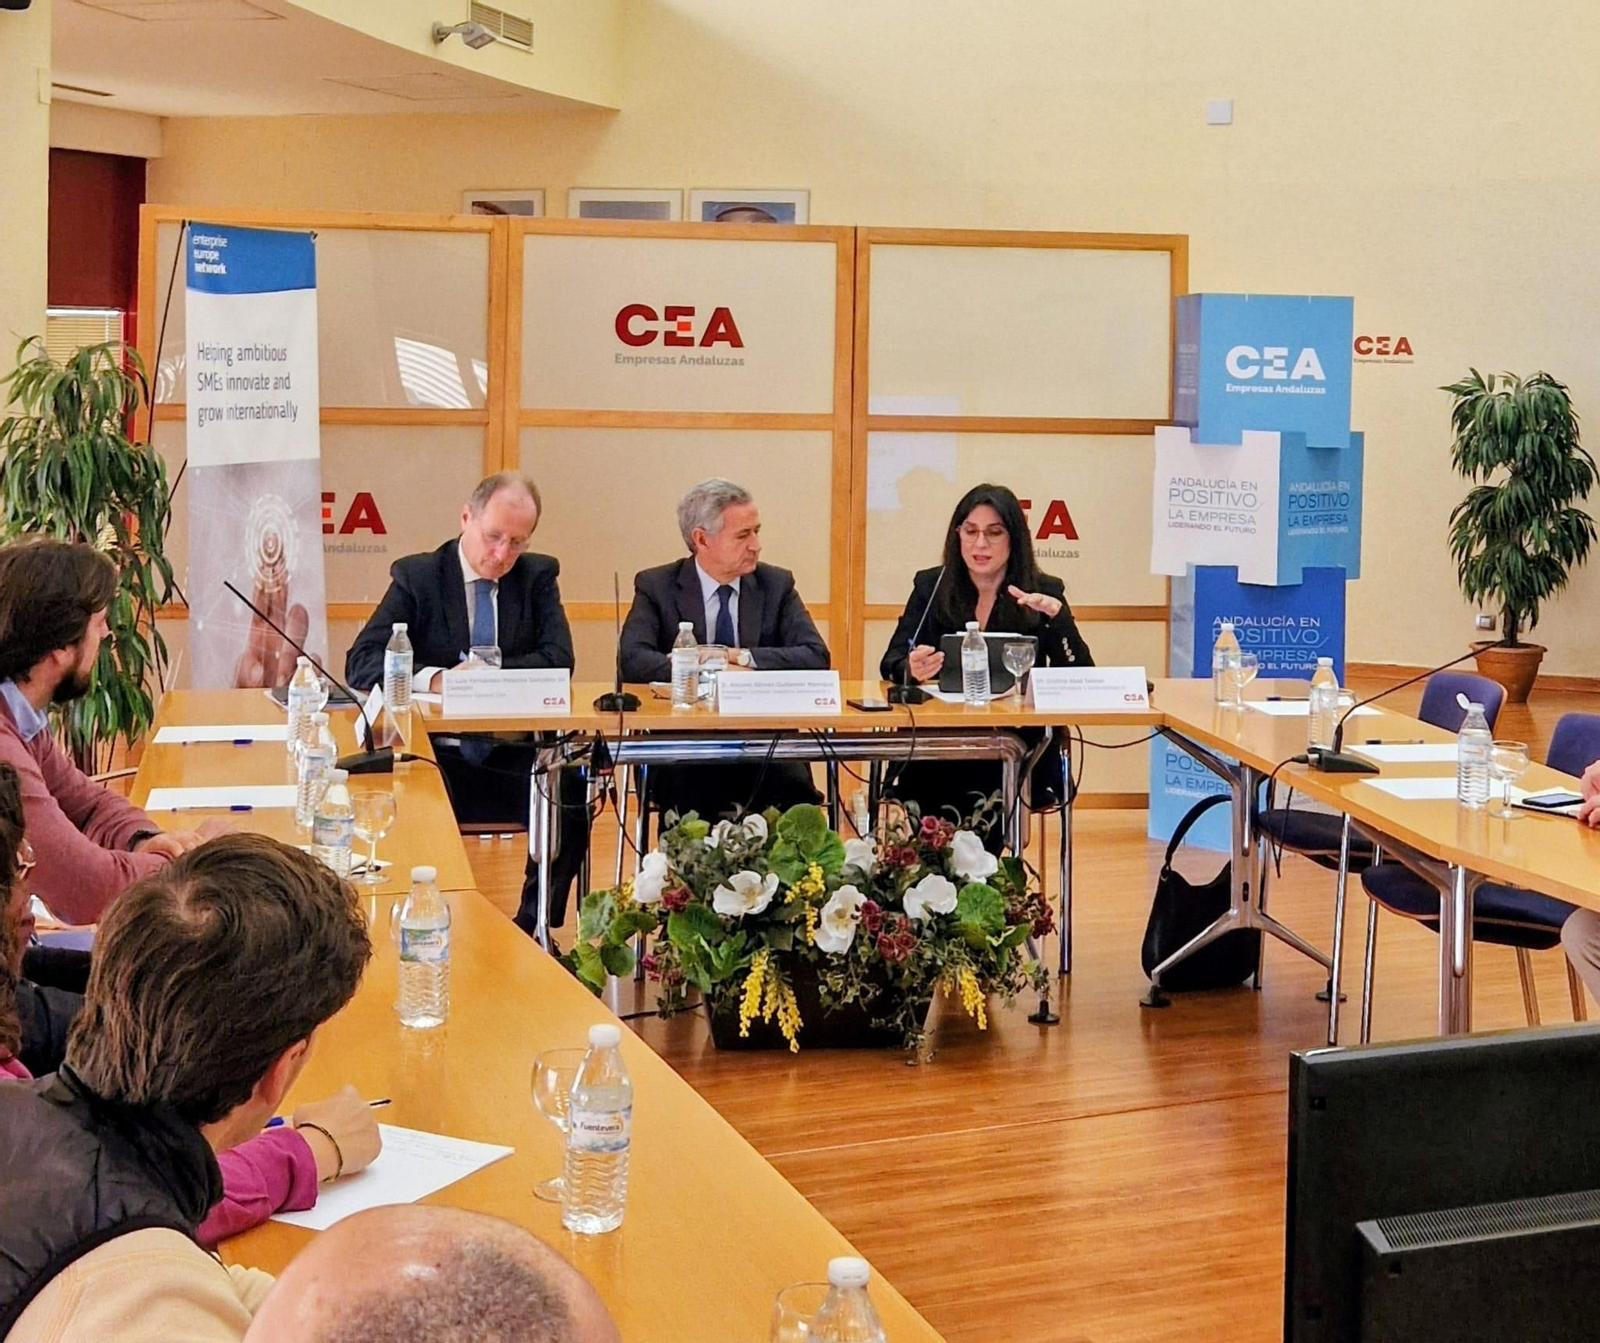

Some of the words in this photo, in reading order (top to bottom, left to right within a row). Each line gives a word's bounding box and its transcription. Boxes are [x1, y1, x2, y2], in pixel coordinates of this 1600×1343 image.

[193, 234, 228, 248] enterprise
[193, 249, 220, 262] europe
[195, 262, 227, 274] network
[615, 303, 744, 348] CEA
[1354, 335, 1414, 356] CEA
[197, 342, 233, 367] Helping
[237, 343, 288, 362] ambitious
[614, 352, 677, 366] Empresas
[679, 354, 745, 366] Andaluzas
[1225, 345, 1327, 380] CEA
[197, 371, 223, 391] SMEs
[226, 371, 270, 391] innovate
[273, 371, 291, 390] and
[1225, 383, 1274, 394] Empresas
[1275, 384, 1327, 395] Andaluzas
[198, 407, 223, 428] grow
[226, 400, 298, 423] internationally
[1169, 475, 1237, 490] ANDALUCÍA
[1240, 481, 1258, 492] EN
[1168, 487, 1257, 508] POSITIVO
[1288, 492, 1350, 509] POSITIVO
[1168, 509, 1184, 520] LA
[1188, 510, 1256, 526] EMPRESA
[1288, 516, 1300, 527] LA
[1302, 513, 1348, 526] EMPRESA
[1168, 521, 1212, 531] LIDERANDO
[1213, 524, 1223, 532] EL
[1224, 525, 1257, 535] FUTURO
[1212, 614, 1295, 627] ANDALUCÍA
[1300, 616, 1320, 627] EN
[1267, 662, 1279, 670] EL
[543, 697, 566, 706] CEA
[814, 697, 837, 706] CEA
[1124, 693, 1145, 702] CEA
[1165, 773, 1181, 787] LA
[580, 1121, 620, 1132] Fuentevera
